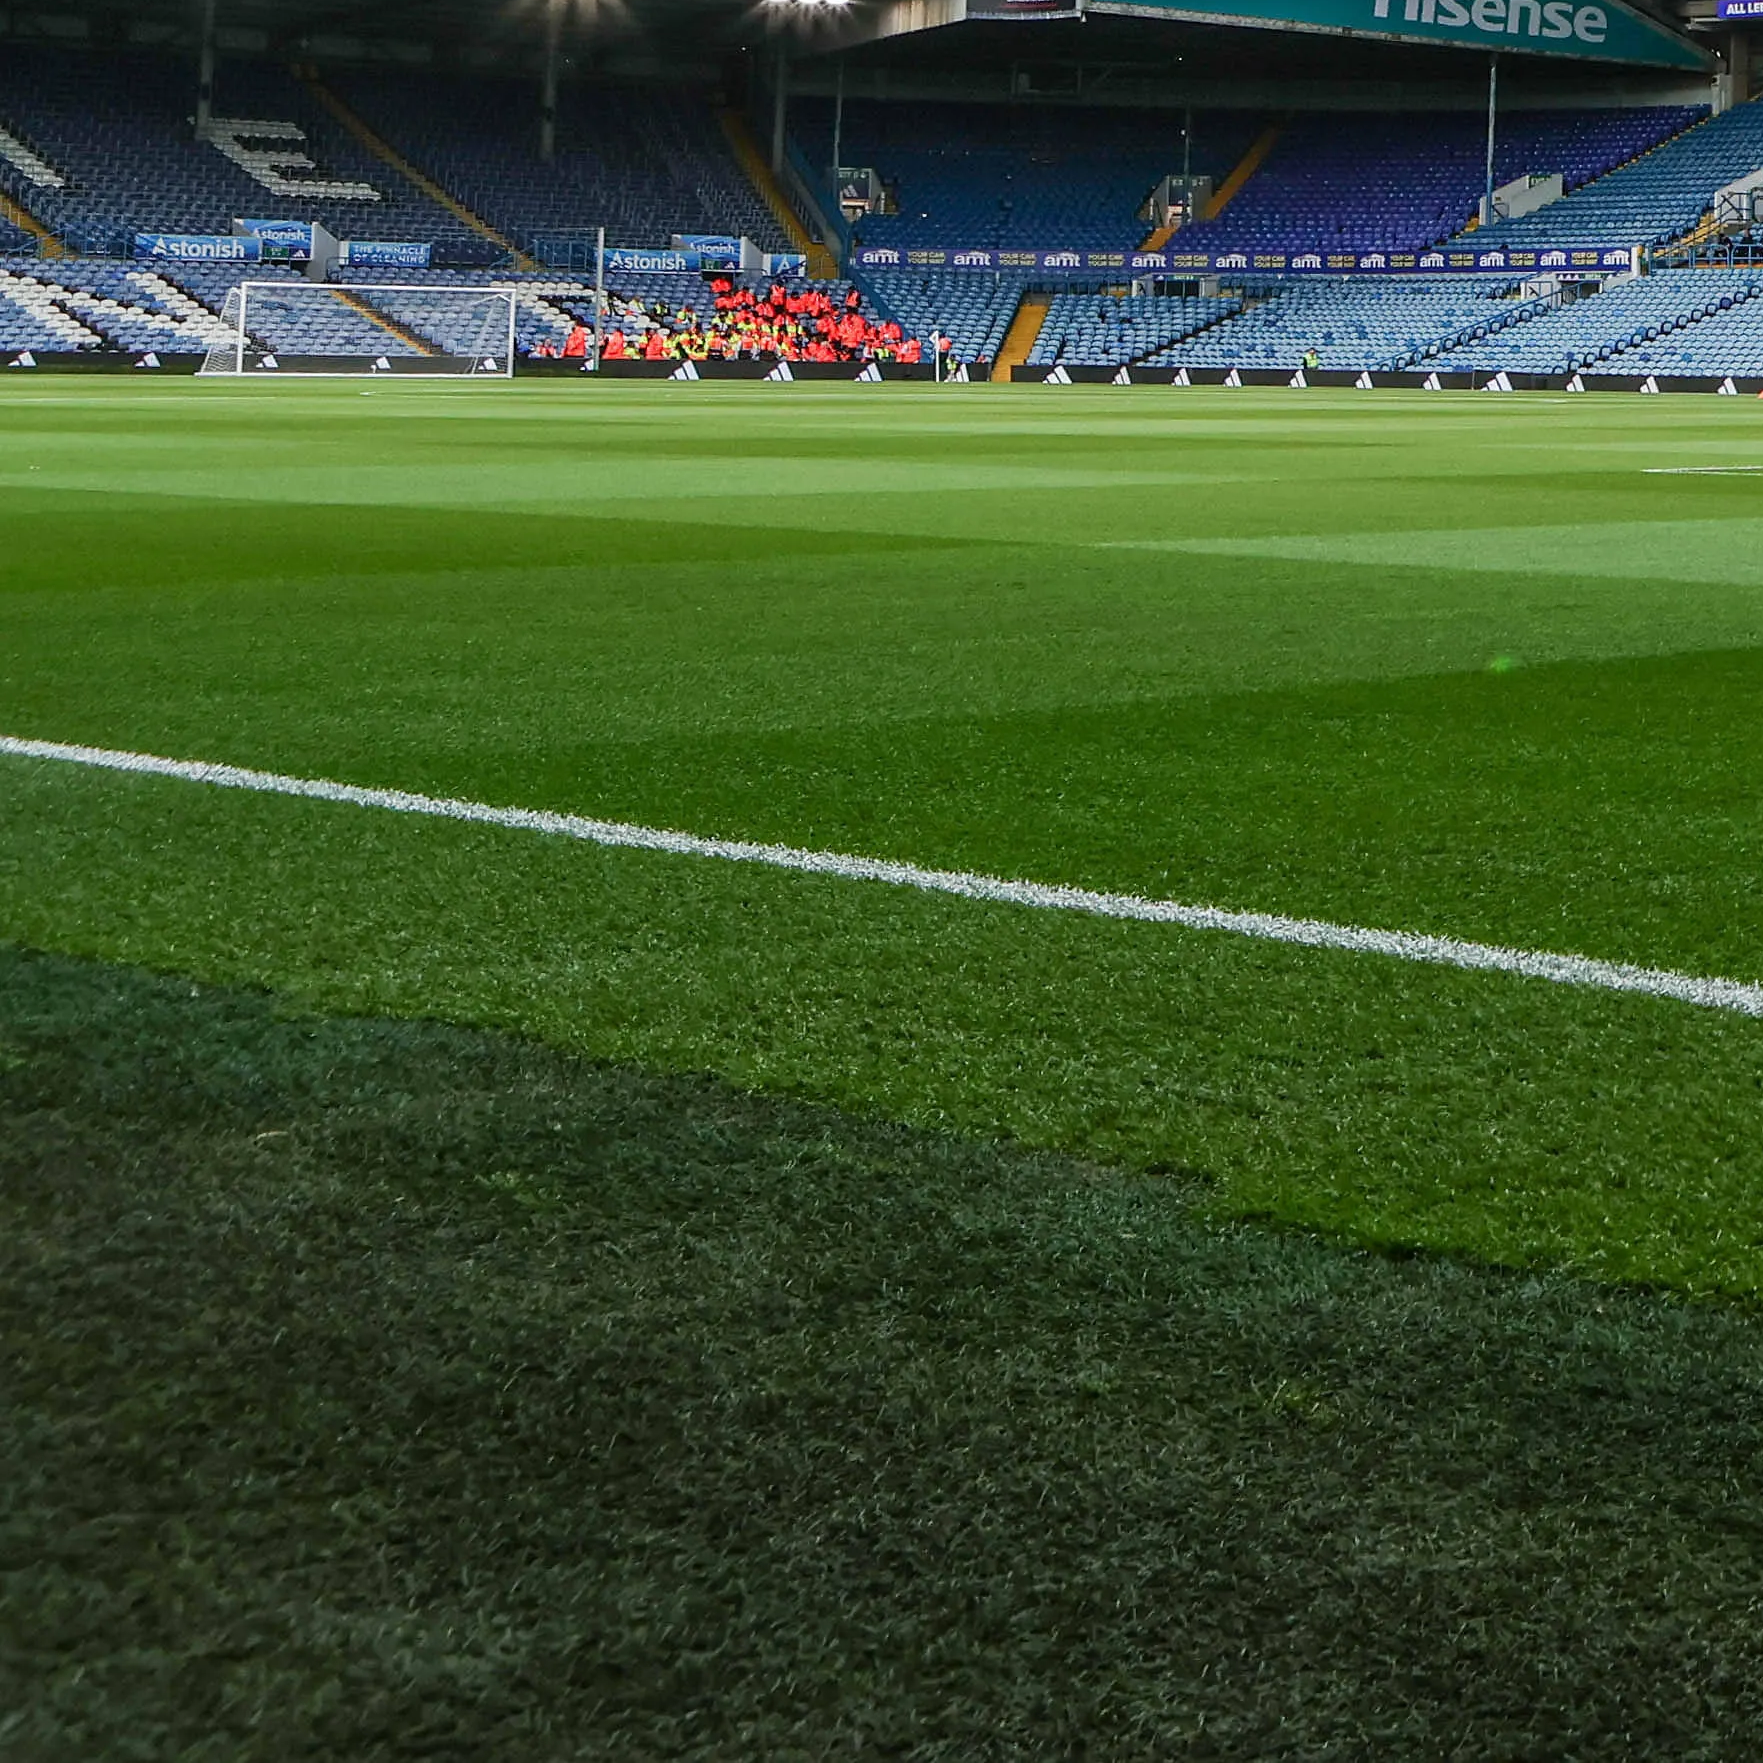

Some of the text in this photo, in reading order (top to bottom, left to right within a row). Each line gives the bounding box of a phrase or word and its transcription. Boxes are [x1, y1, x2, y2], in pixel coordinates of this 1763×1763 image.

[1727, 3, 1746, 14] ALL
[251, 228, 305, 241] Astonish
[152, 237, 244, 258] Astonish
[610, 251, 686, 270] Astonish
[862, 250, 900, 264] amt
[954, 253, 991, 266] amt
[1044, 254, 1081, 268] amt
[1132, 255, 1166, 268] amt
[1215, 256, 1247, 268] amt
[1292, 256, 1321, 269] amt
